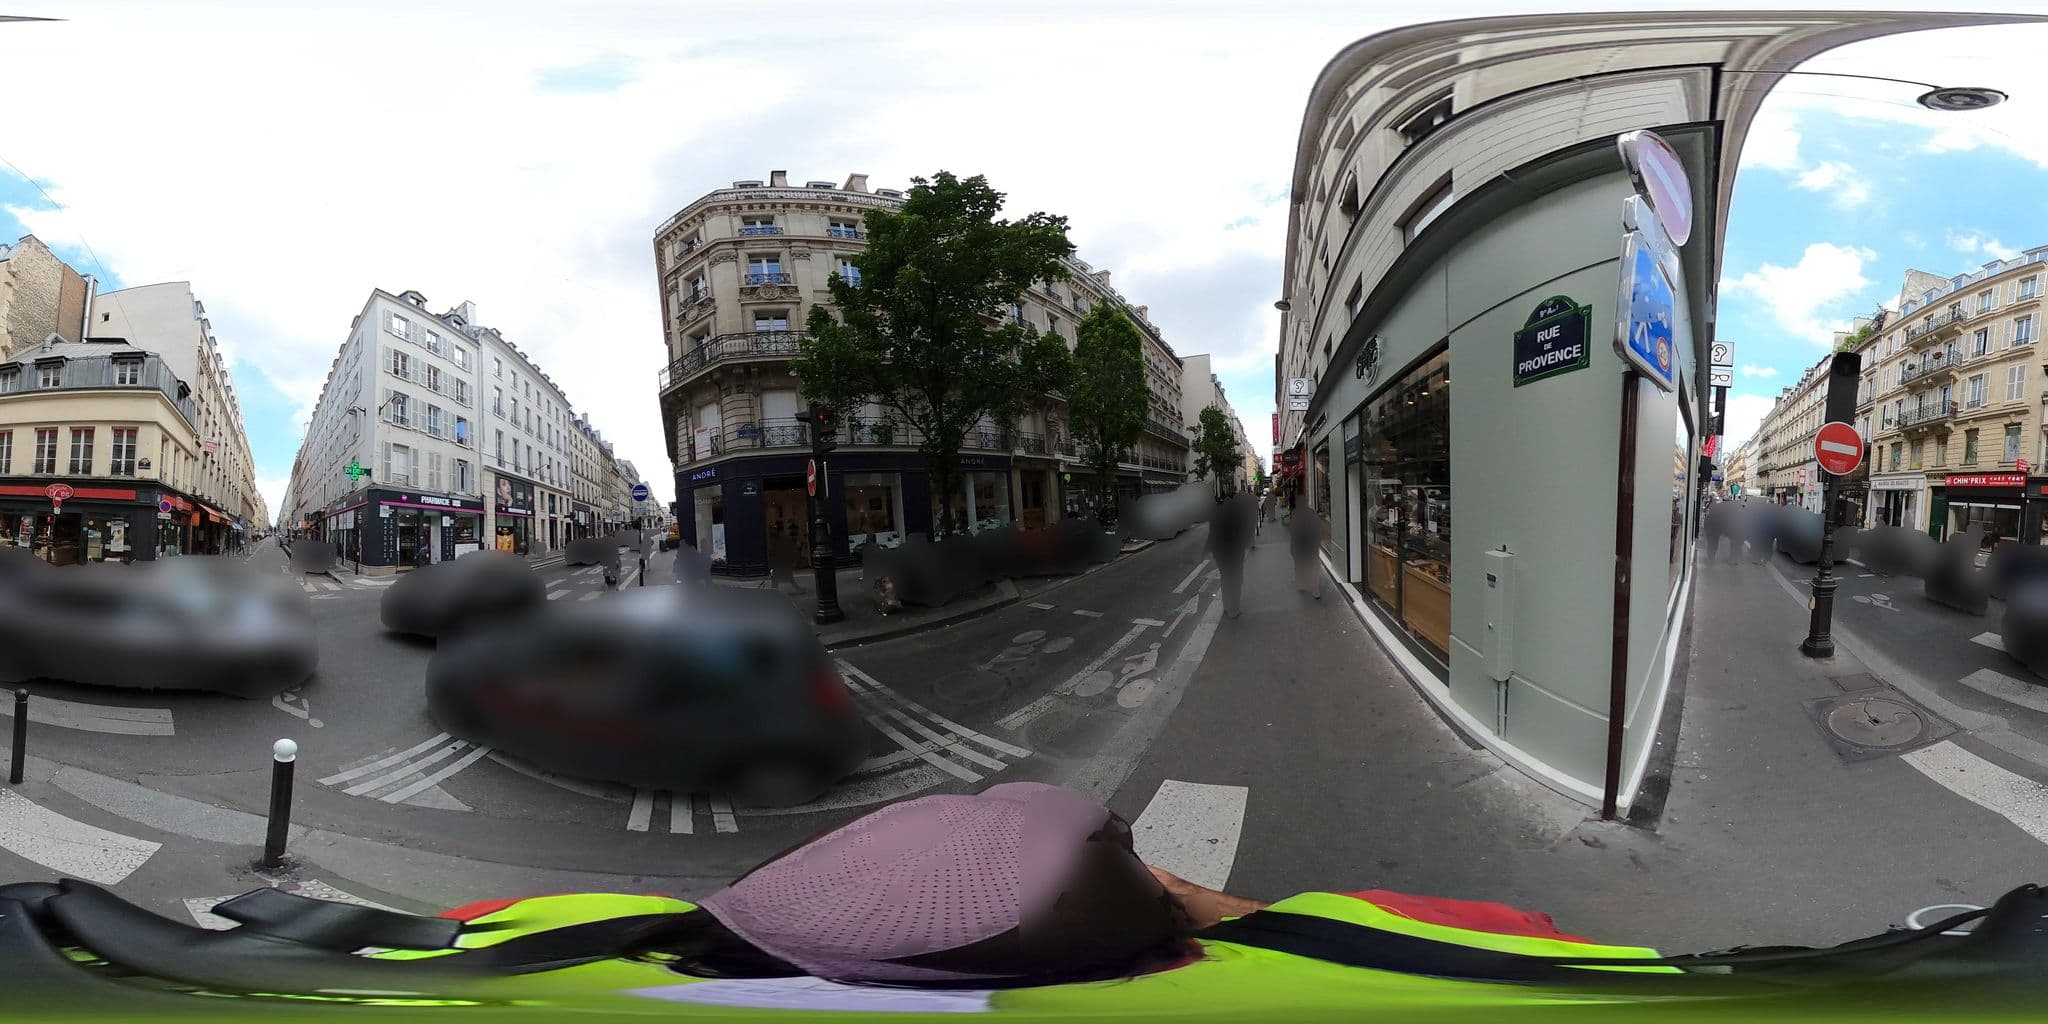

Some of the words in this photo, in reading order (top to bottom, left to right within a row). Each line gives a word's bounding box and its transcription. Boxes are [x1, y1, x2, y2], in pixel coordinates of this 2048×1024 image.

[1537, 325, 1561, 343] RUE
[1543, 342, 1553, 351] DE
[1518, 344, 1582, 375] PROVENCE
[692, 468, 717, 481] ANDRÉ
[1953, 477, 1986, 485] CHIN'PRIX
[421, 495, 451, 506] PHARMACIE
